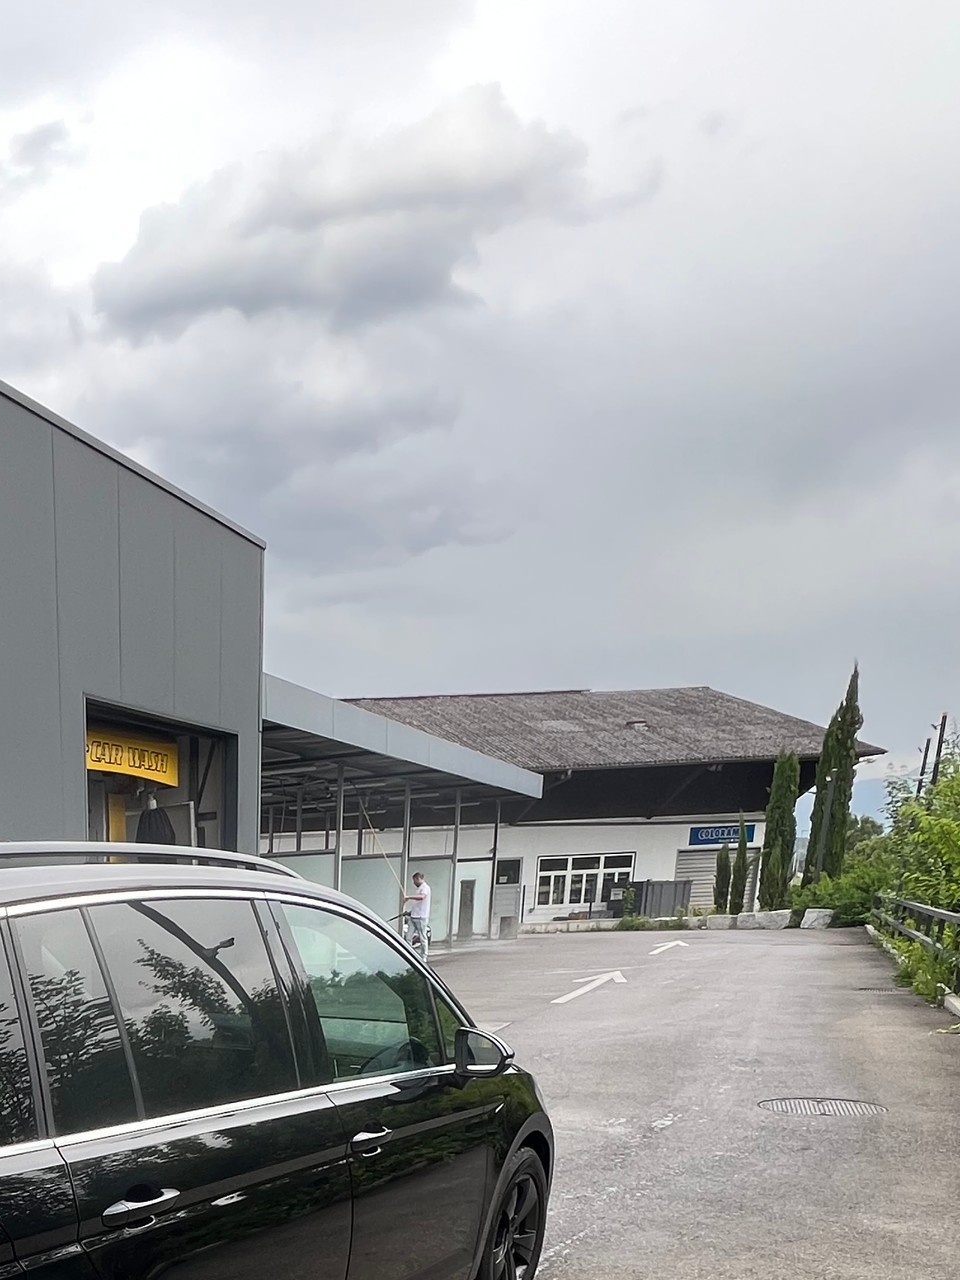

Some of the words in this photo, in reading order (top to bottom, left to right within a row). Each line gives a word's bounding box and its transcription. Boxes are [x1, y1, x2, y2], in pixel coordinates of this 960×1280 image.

[90, 740, 124, 766] CAR
[127, 746, 169, 773] WASH
[698, 827, 743, 840] COLORAM
